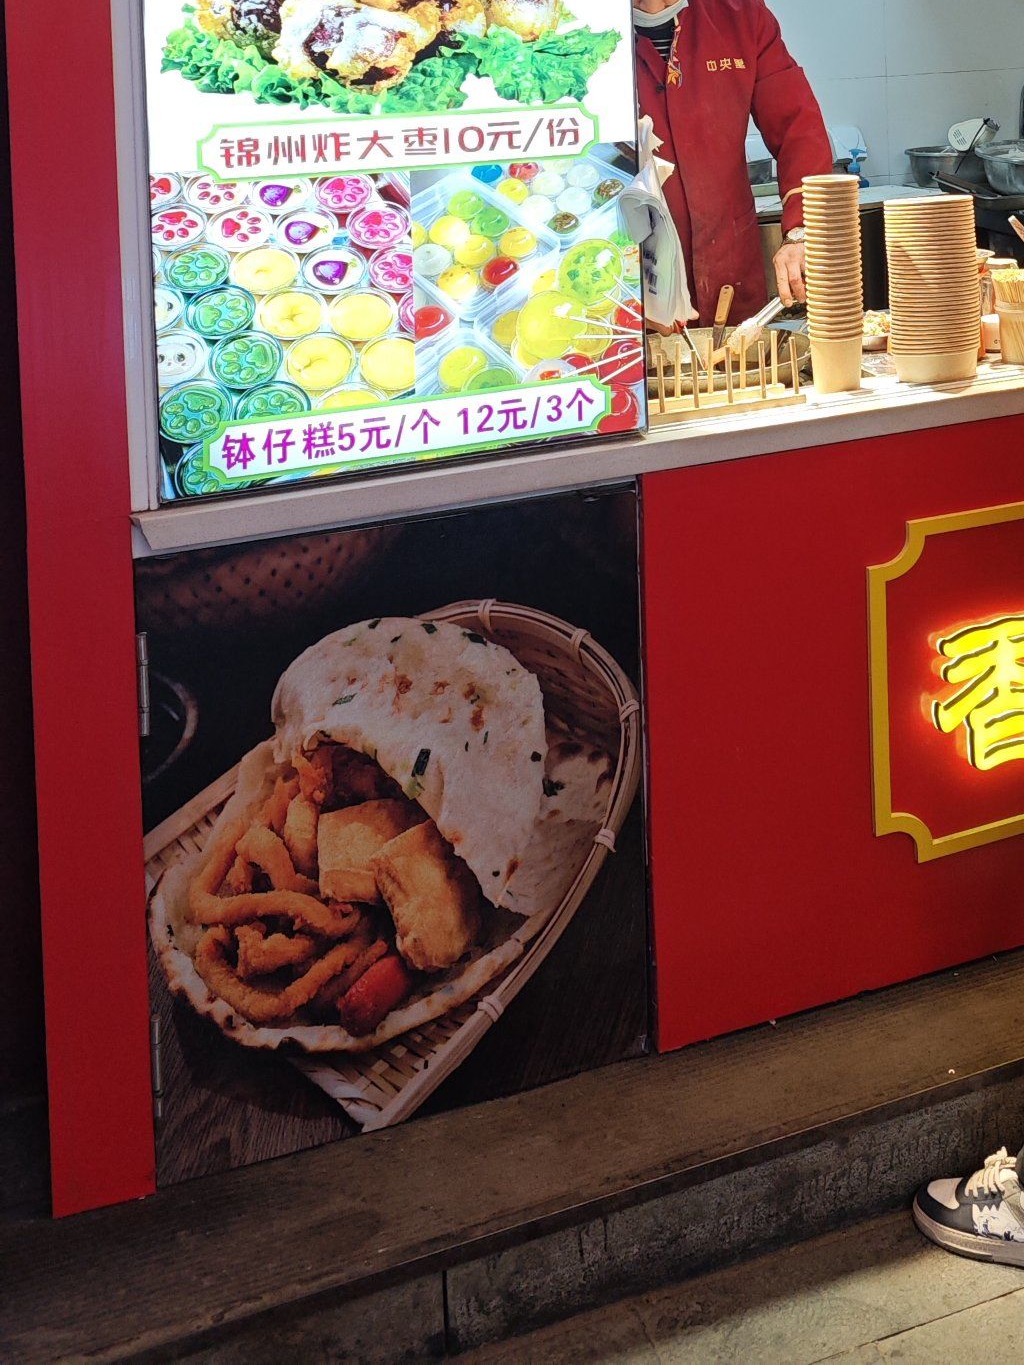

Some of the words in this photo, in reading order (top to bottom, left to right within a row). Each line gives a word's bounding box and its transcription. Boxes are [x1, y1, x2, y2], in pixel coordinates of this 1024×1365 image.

[219, 117, 580, 169] 锦州炸大枣10元/份
[221, 408, 440, 470] 钵仔糕5元/个
[457, 387, 594, 435] 12元/3个
